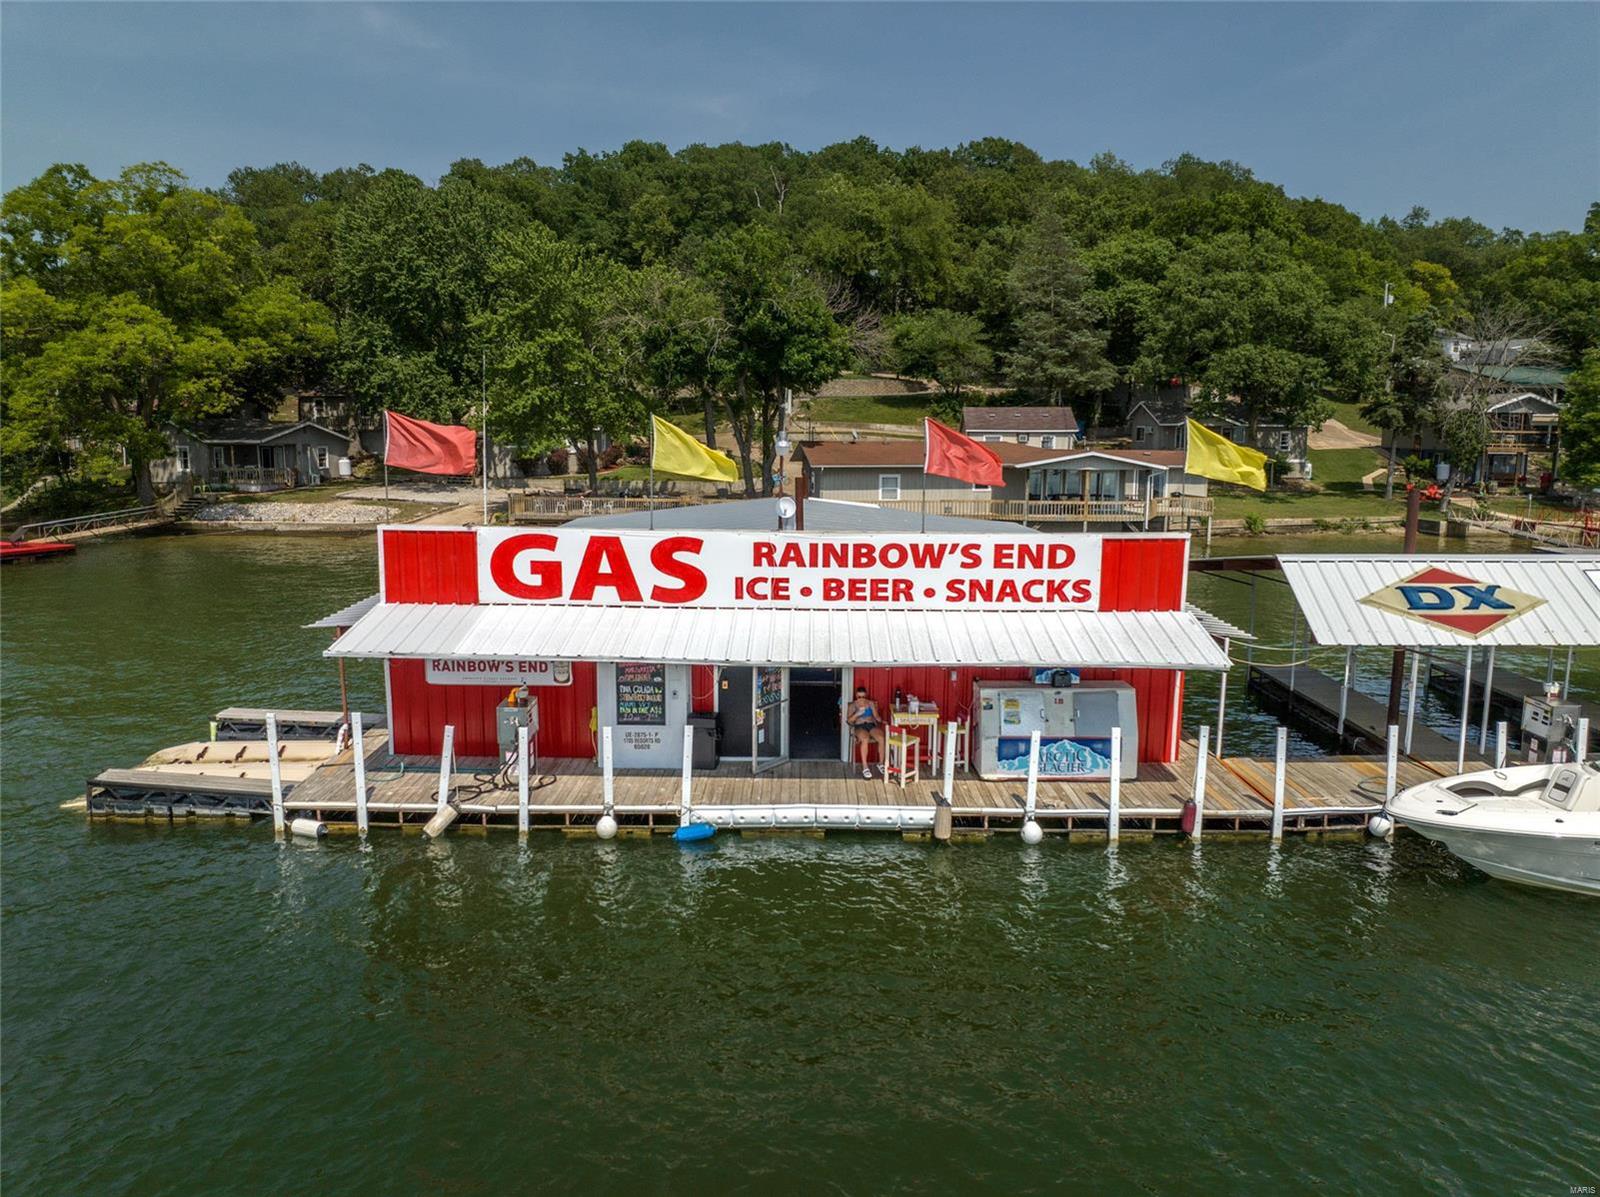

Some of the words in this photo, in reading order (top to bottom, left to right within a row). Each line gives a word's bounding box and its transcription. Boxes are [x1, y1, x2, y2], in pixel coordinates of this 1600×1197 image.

[490, 533, 708, 604] GAS
[753, 542, 983, 569] RAINBOW'S
[993, 544, 1076, 570] END
[735, 577, 791, 601] ICE
[823, 578, 915, 602] BEER
[946, 579, 1092, 604] SNACKS
[1395, 585, 1516, 611] DX
[432, 660, 515, 673] RAINBOW'S
[518, 661, 549, 674] END
[1038, 748, 1087, 762] ARCTIC
